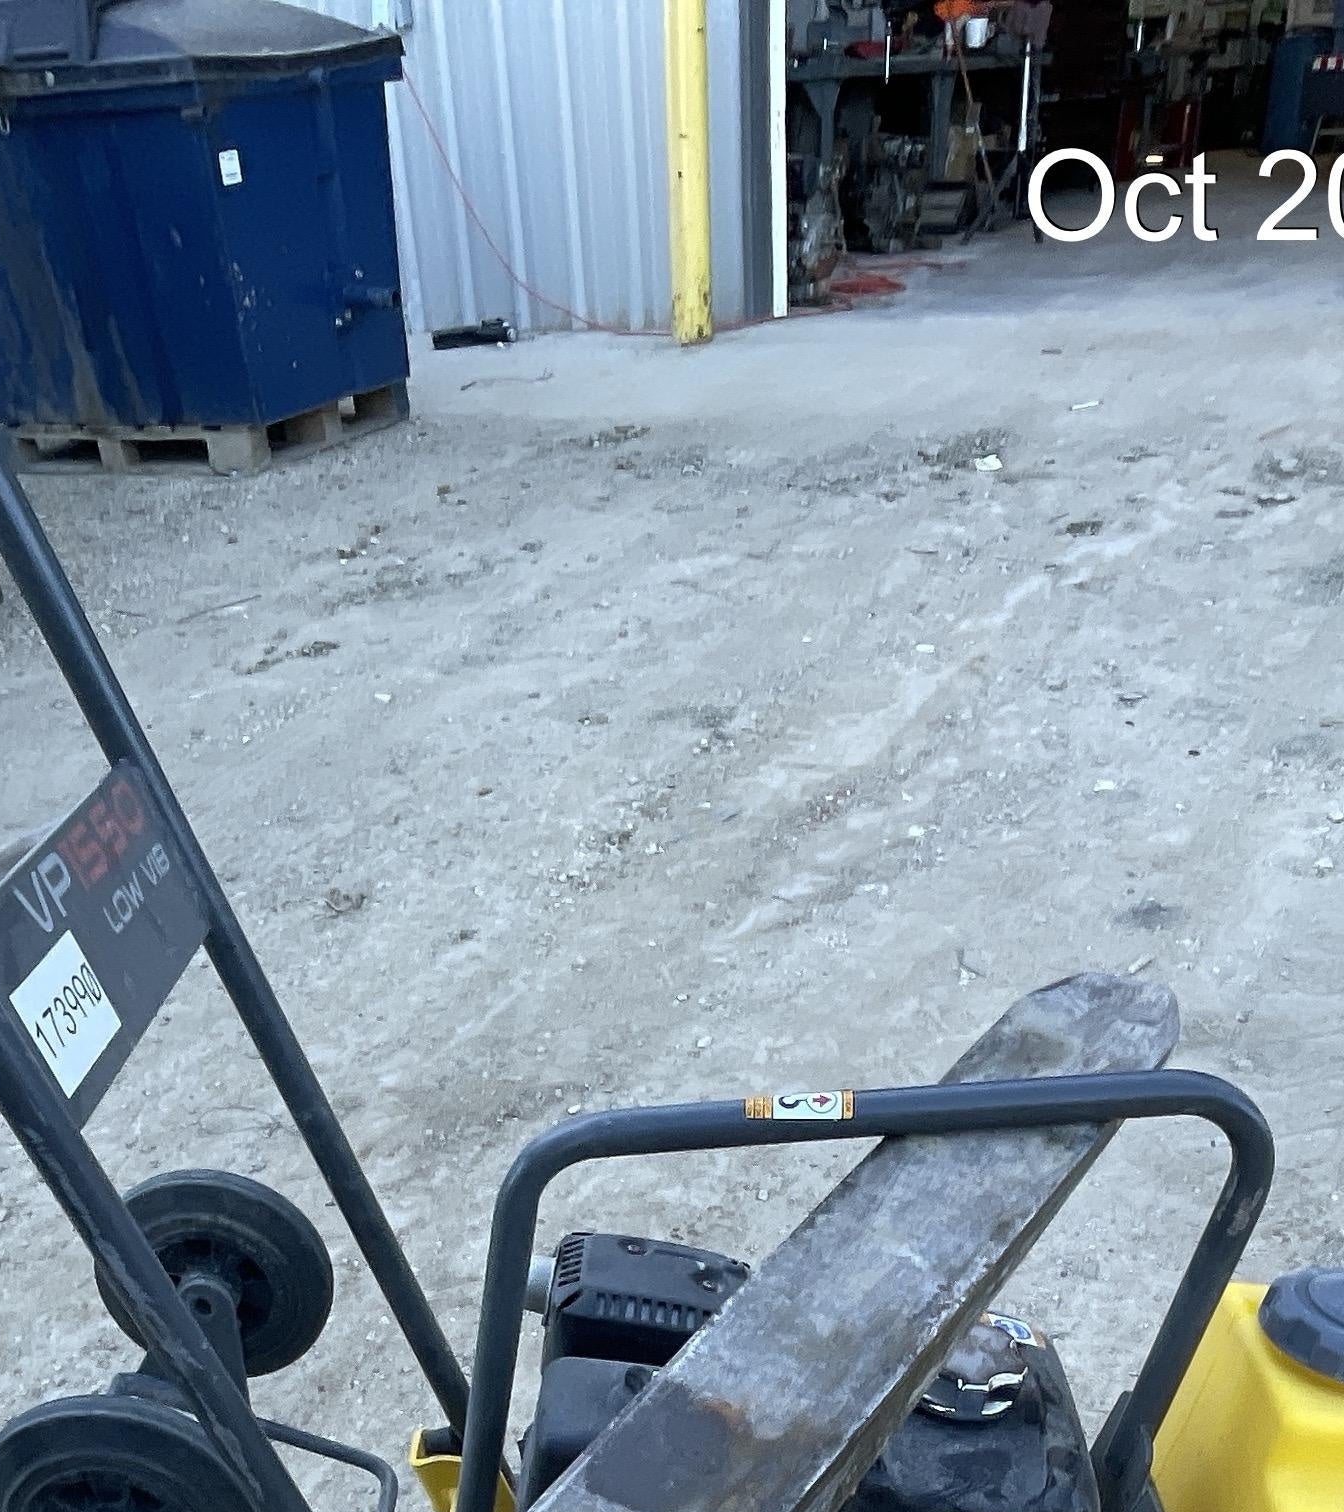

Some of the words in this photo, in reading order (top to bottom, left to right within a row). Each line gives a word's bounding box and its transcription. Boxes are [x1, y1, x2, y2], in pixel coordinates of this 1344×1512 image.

[102, 871, 145, 935] LOW
[139, 841, 171, 886] VIB
[34, 961, 102, 1059] 173990
